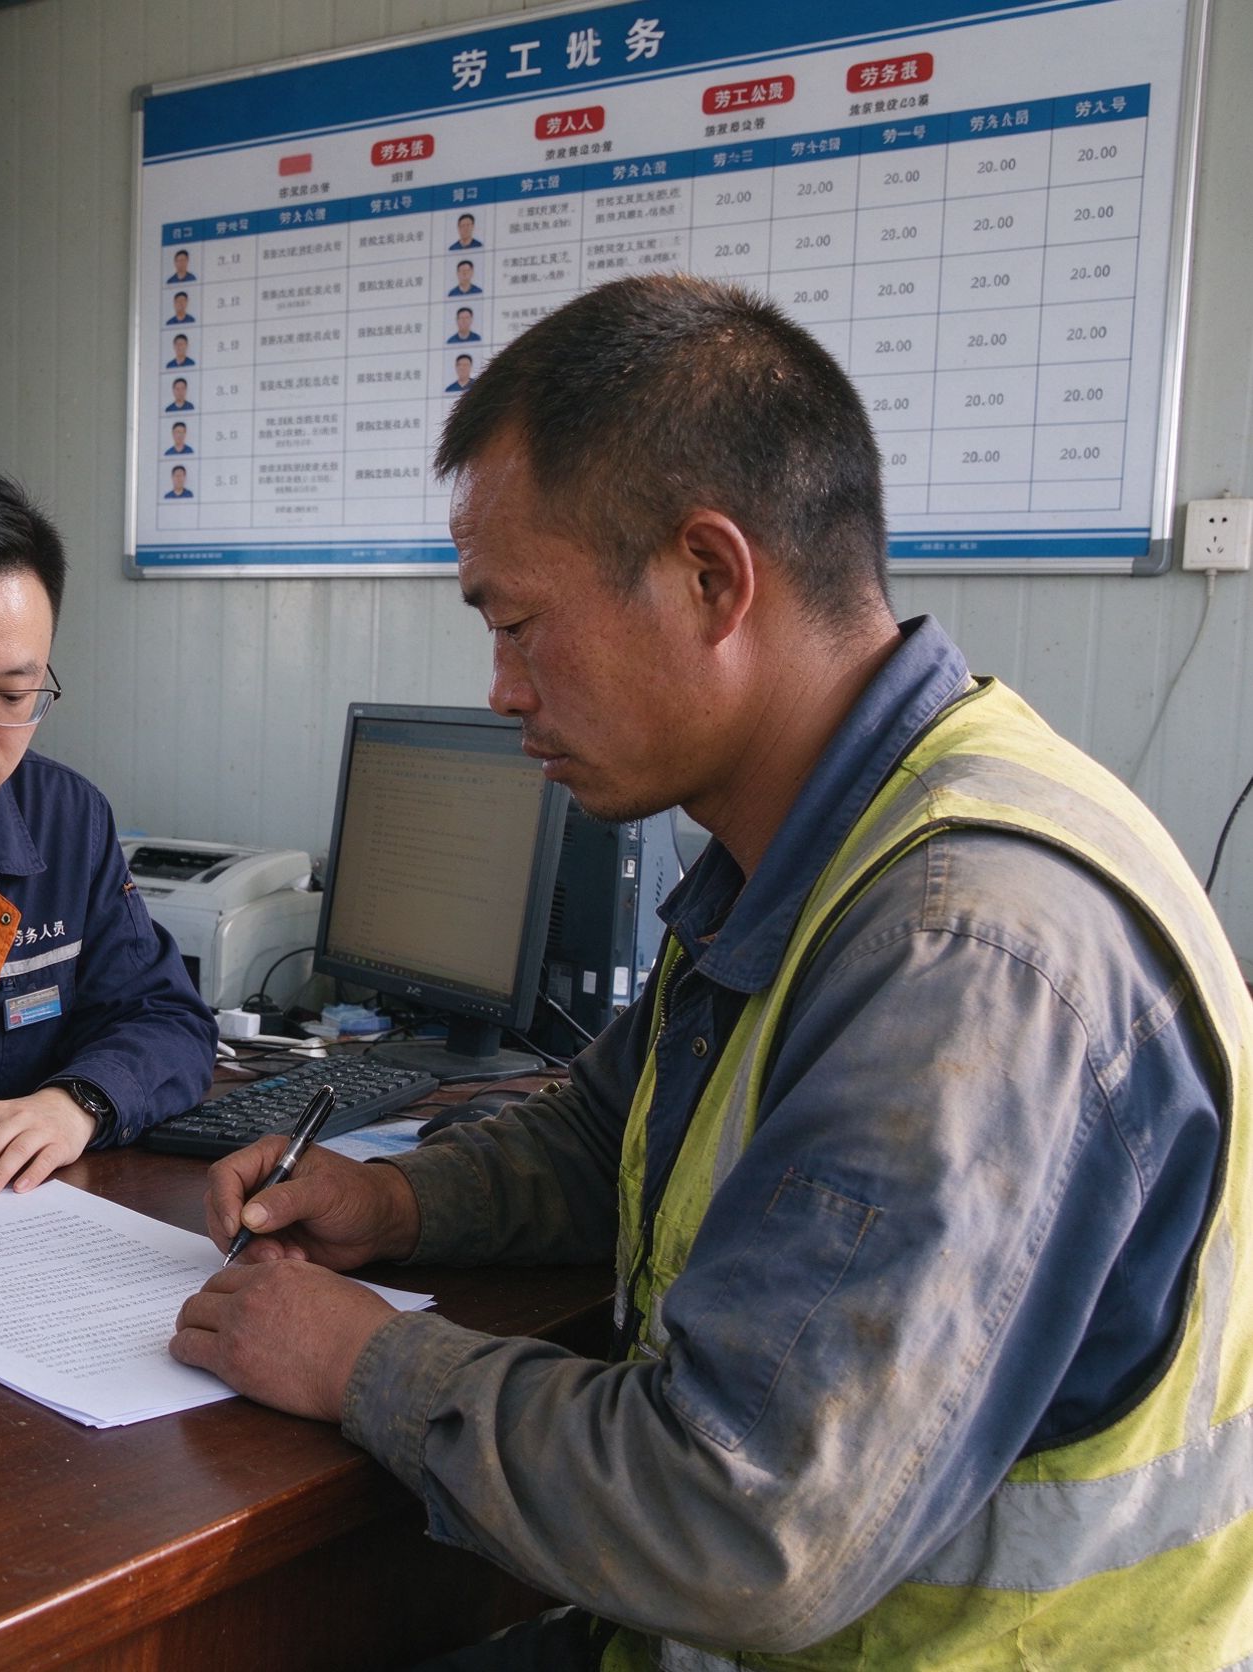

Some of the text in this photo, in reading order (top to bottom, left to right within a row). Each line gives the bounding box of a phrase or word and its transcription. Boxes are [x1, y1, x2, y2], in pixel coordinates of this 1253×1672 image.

[1077, 145, 1117, 162] 20.00
[977, 158, 1016, 174] 20.00
[884, 170, 920, 185] 20.00
[797, 181, 833, 196] 20.00
[715, 191, 752, 206] 20.00
[1074, 205, 1114, 222] 20.00
[973, 215, 1014, 231] 20.00
[881, 226, 917, 241] 20.00
[795, 234, 831, 249] 20.00
[715, 243, 750, 257] 20.00
[1070, 264, 1110, 280] 20.00
[970, 274, 1010, 289] 20.00
[794, 289, 829, 304] 20.00
[878, 282, 914, 297] 20.00
[967, 333, 1007, 348] 20.00
[1066, 326, 1107, 341] 20.00
[875, 339, 912, 354] 20.00
[964, 393, 1004, 407] 20.00
[1063, 388, 1103, 403] 20.00
[873, 398, 909, 412] 20.00
[962, 450, 1000, 464] 20.00
[1059, 447, 1100, 461] 20.00
